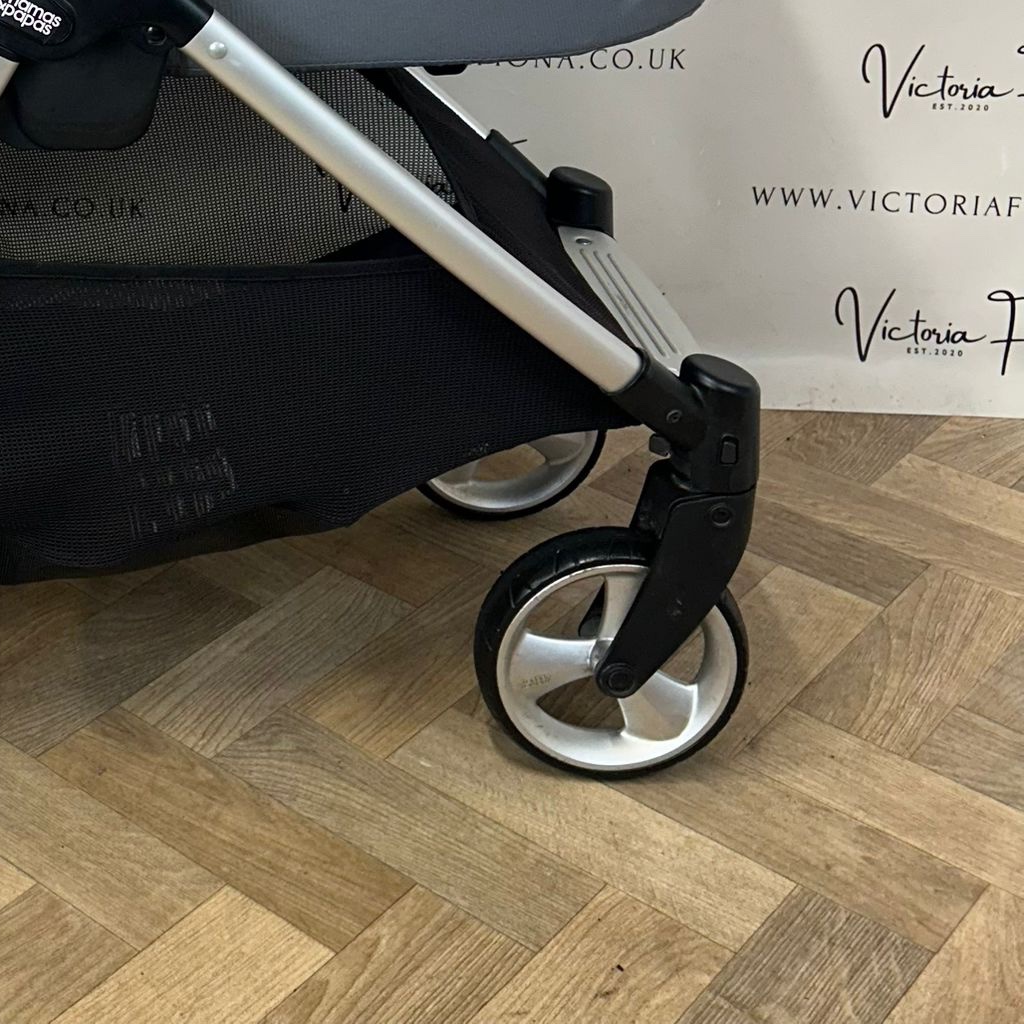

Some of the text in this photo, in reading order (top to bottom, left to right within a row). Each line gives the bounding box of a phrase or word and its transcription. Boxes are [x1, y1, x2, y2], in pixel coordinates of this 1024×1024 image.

[862, 43, 1014, 119] Victoria
[932, 103, 989, 111] EST.2020
[835, 287, 986, 362] Victoria
[907, 347, 963, 356] EST.2020
